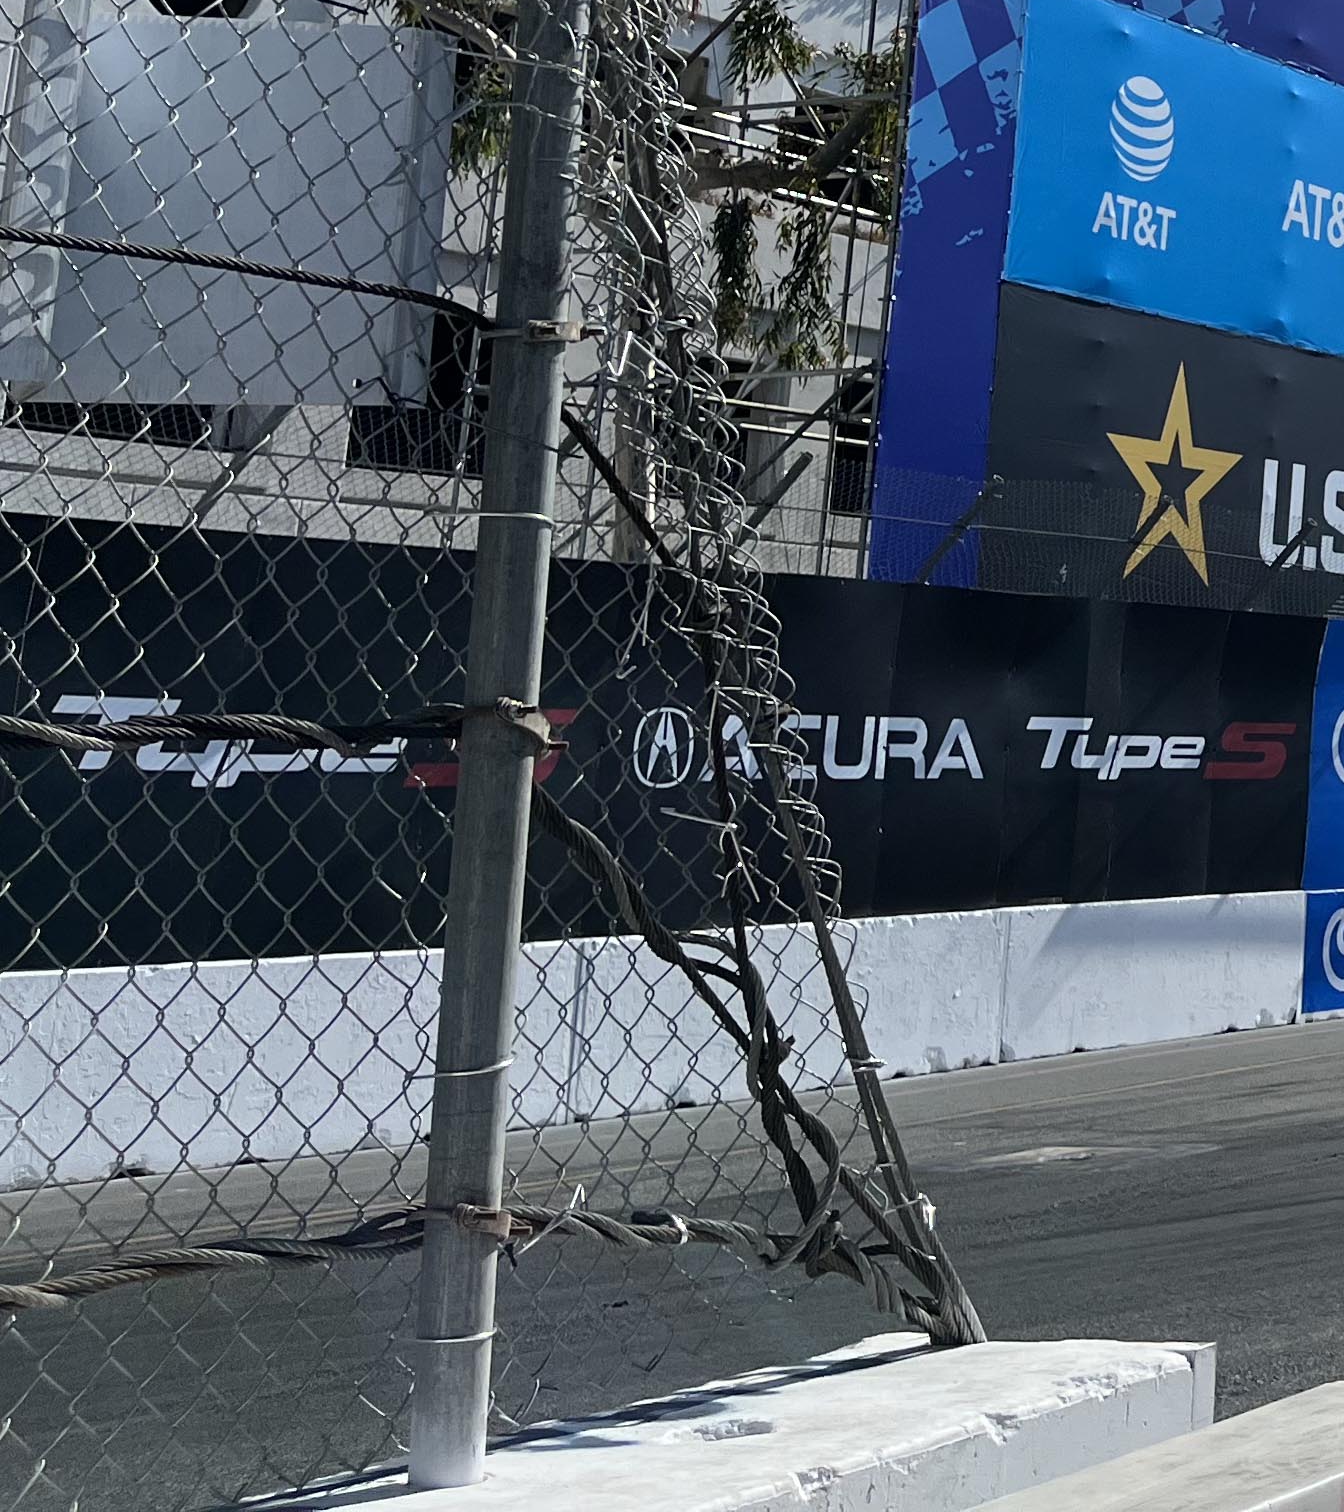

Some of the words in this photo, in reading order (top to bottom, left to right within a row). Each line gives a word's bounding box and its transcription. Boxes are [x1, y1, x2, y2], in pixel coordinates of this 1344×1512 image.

[1092, 191, 1177, 251] AT&T
[698, 714, 983, 781] ACURA
[1026, 716, 1205, 780] Type
[1202, 721, 1297, 780] S
